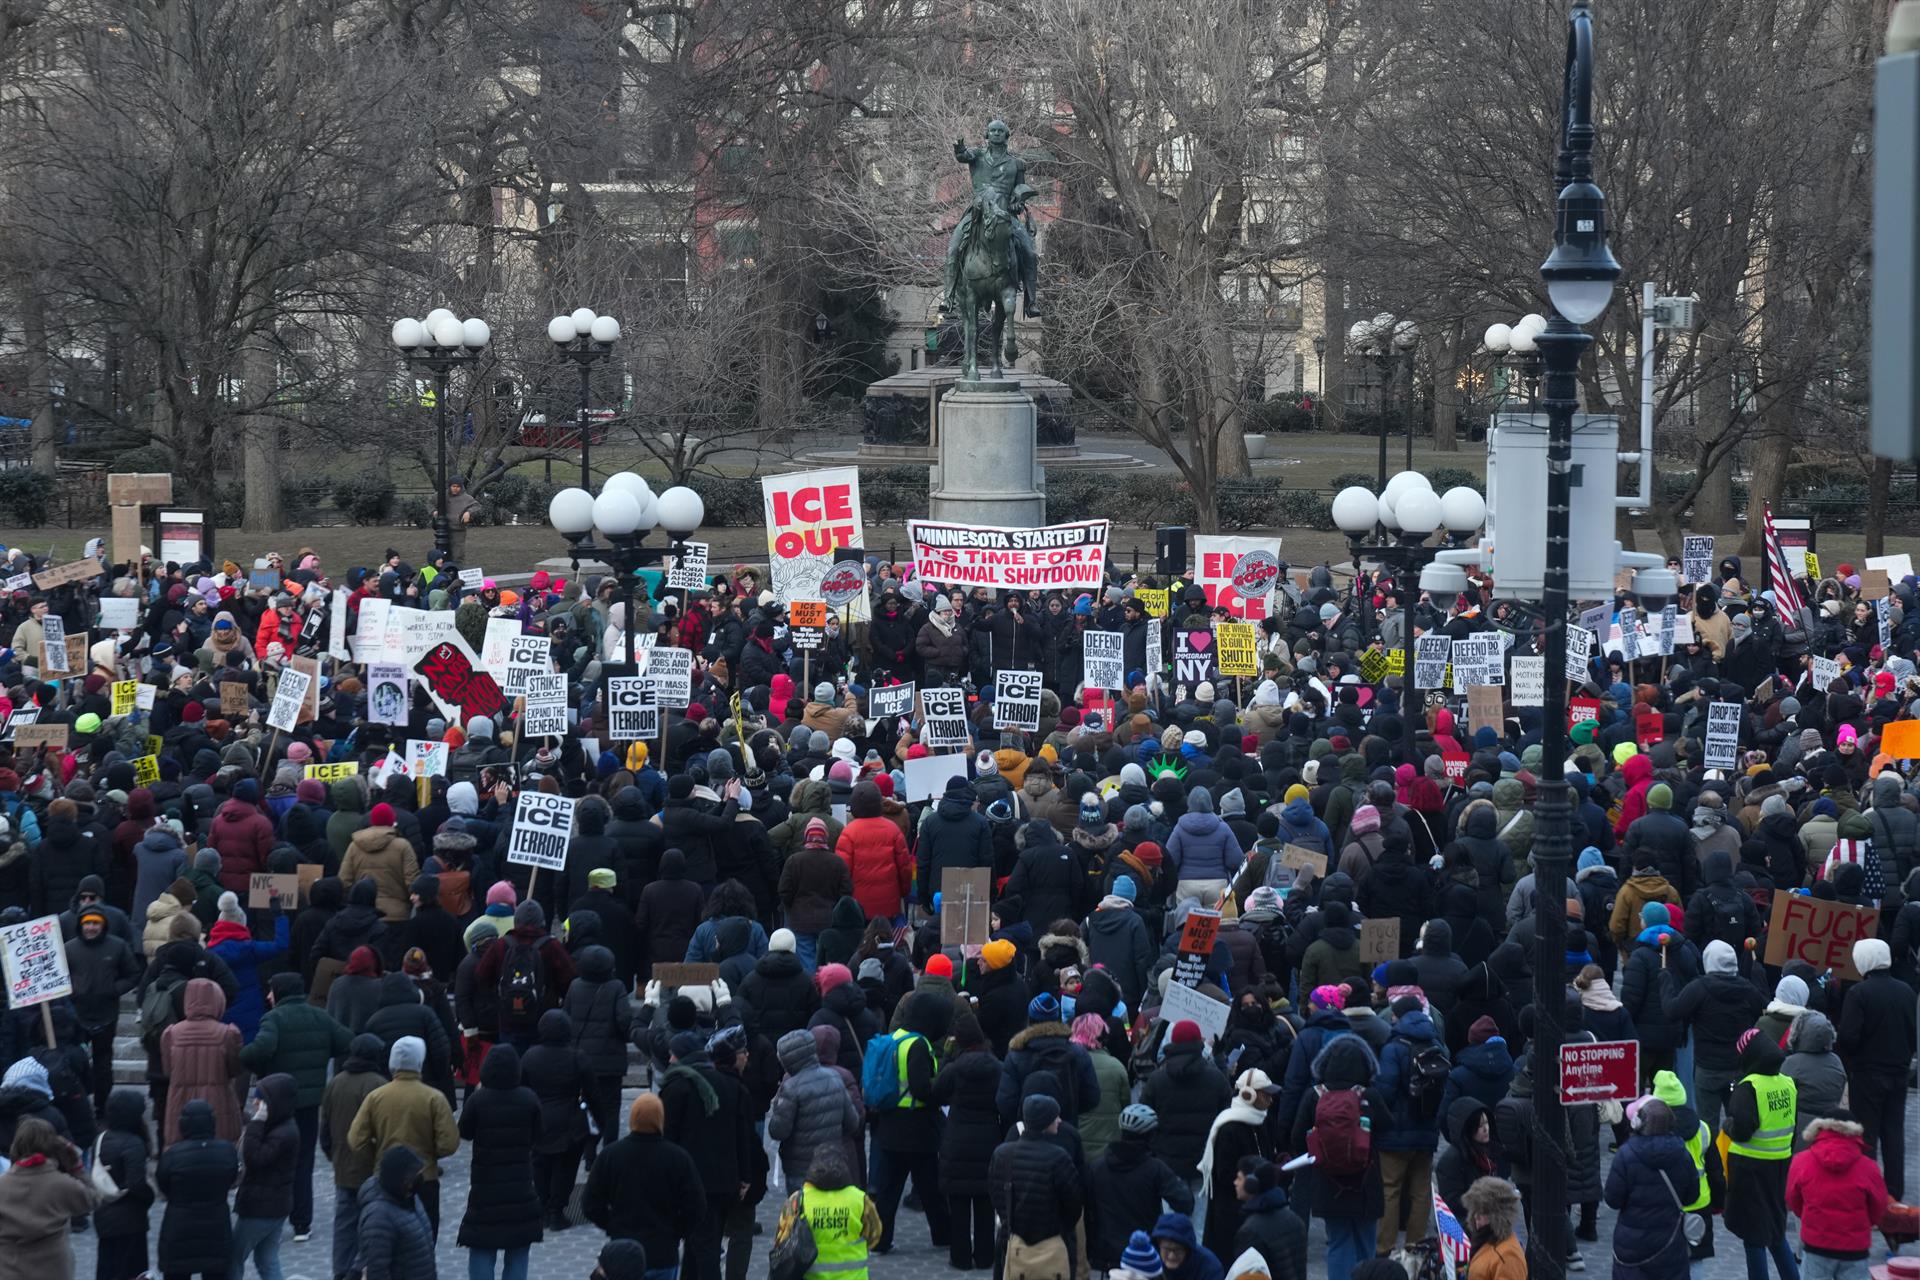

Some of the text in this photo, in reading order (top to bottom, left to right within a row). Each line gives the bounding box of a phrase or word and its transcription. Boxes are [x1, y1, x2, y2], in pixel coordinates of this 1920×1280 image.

[772, 484, 853, 526] ICE
[775, 525, 854, 559] OUT
[916, 525, 1105, 549] MINNESOTA STARTED IT
[1686, 538, 1713, 550] DEFEND
[917, 543, 1102, 565] T'S TIME FOR A
[1004, 565, 1101, 585] SHUTDOWN
[1233, 565, 1277, 587] GOOD
[822, 580, 863, 592] GOOD
[1203, 584, 1267, 619] ICE
[1220, 624, 1251, 633] THE WHOLE
[511, 638, 548, 649] STOP
[1086, 633, 1121, 650] DEFEND
[1176, 632, 1189, 653] I
[1221, 638, 1252, 648] IS GUILTY
[1419, 638, 1449, 652] DEFEND
[509, 648, 547, 665] ICE
[650, 651, 689, 659] MONEY FOR
[1085, 648, 1122, 660] DEMOCRACY:
[1221, 650, 1254, 663] SHUT IT
[1454, 642, 1487, 657] DEFEND
[649, 658, 689, 668] JOBS AND
[1086, 660, 1122, 672] IT'S TIME FOR
[1453, 656, 1487, 666] DEMOCRACY:
[1515, 660, 1544, 669] TRUMP'S
[649, 668, 689, 677] EDUCATION,
[1090, 669, 1119, 680] A GENERAL
[1176, 659, 1211, 681] NY
[1454, 668, 1465, 677] IT'S
[1466, 668, 1478, 676] TIME
[1479, 667, 1488, 676] FOR
[529, 675, 563, 692] STRIKE!
[611, 680, 655, 690] STOP
[665, 680, 688, 688] MASS
[999, 673, 1041, 685] STOP
[1094, 679, 1116, 688] STRIKE!
[611, 691, 656, 706] ICE
[874, 688, 911, 704] ABOLISH
[922, 692, 961, 701] STOP
[998, 683, 1040, 700] ICE
[527, 706, 565, 719] EXPAND THE
[924, 702, 963, 716] ICE
[997, 701, 1039, 723] TERROR
[1710, 705, 1740, 721] DROP THE
[611, 710, 656, 730] TERROR
[1572, 713, 1597, 722] OFF!
[527, 718, 566, 735] GENERAL
[927, 719, 968, 738] TERROR
[312, 766, 338, 778] ICE
[1446, 761, 1467, 769] HANDS
[521, 794, 572, 811] STOP
[518, 806, 570, 831] ICE
[514, 828, 566, 859] TERROR
[252, 875, 272, 889] NYC
[1782, 899, 1875, 941] FUCK
[5, 921, 51, 944] ICE OUT
[1369, 925, 1399, 940] FUCK
[1369, 941, 1395, 953] ICE
[1787, 933, 1849, 968] ICE
[20, 961, 56, 979] REGIME
[14, 985, 39, 999] WHITE
[1565, 1048, 1625, 1062] NO STOPPING
[1565, 1063, 1603, 1077] Anytime
[1767, 1090, 1778, 1100] RISE
[1768, 1096, 1791, 1112] RESIST
[813, 1207, 849, 1216] RISE AND
[813, 1216, 848, 1229] RESIST
